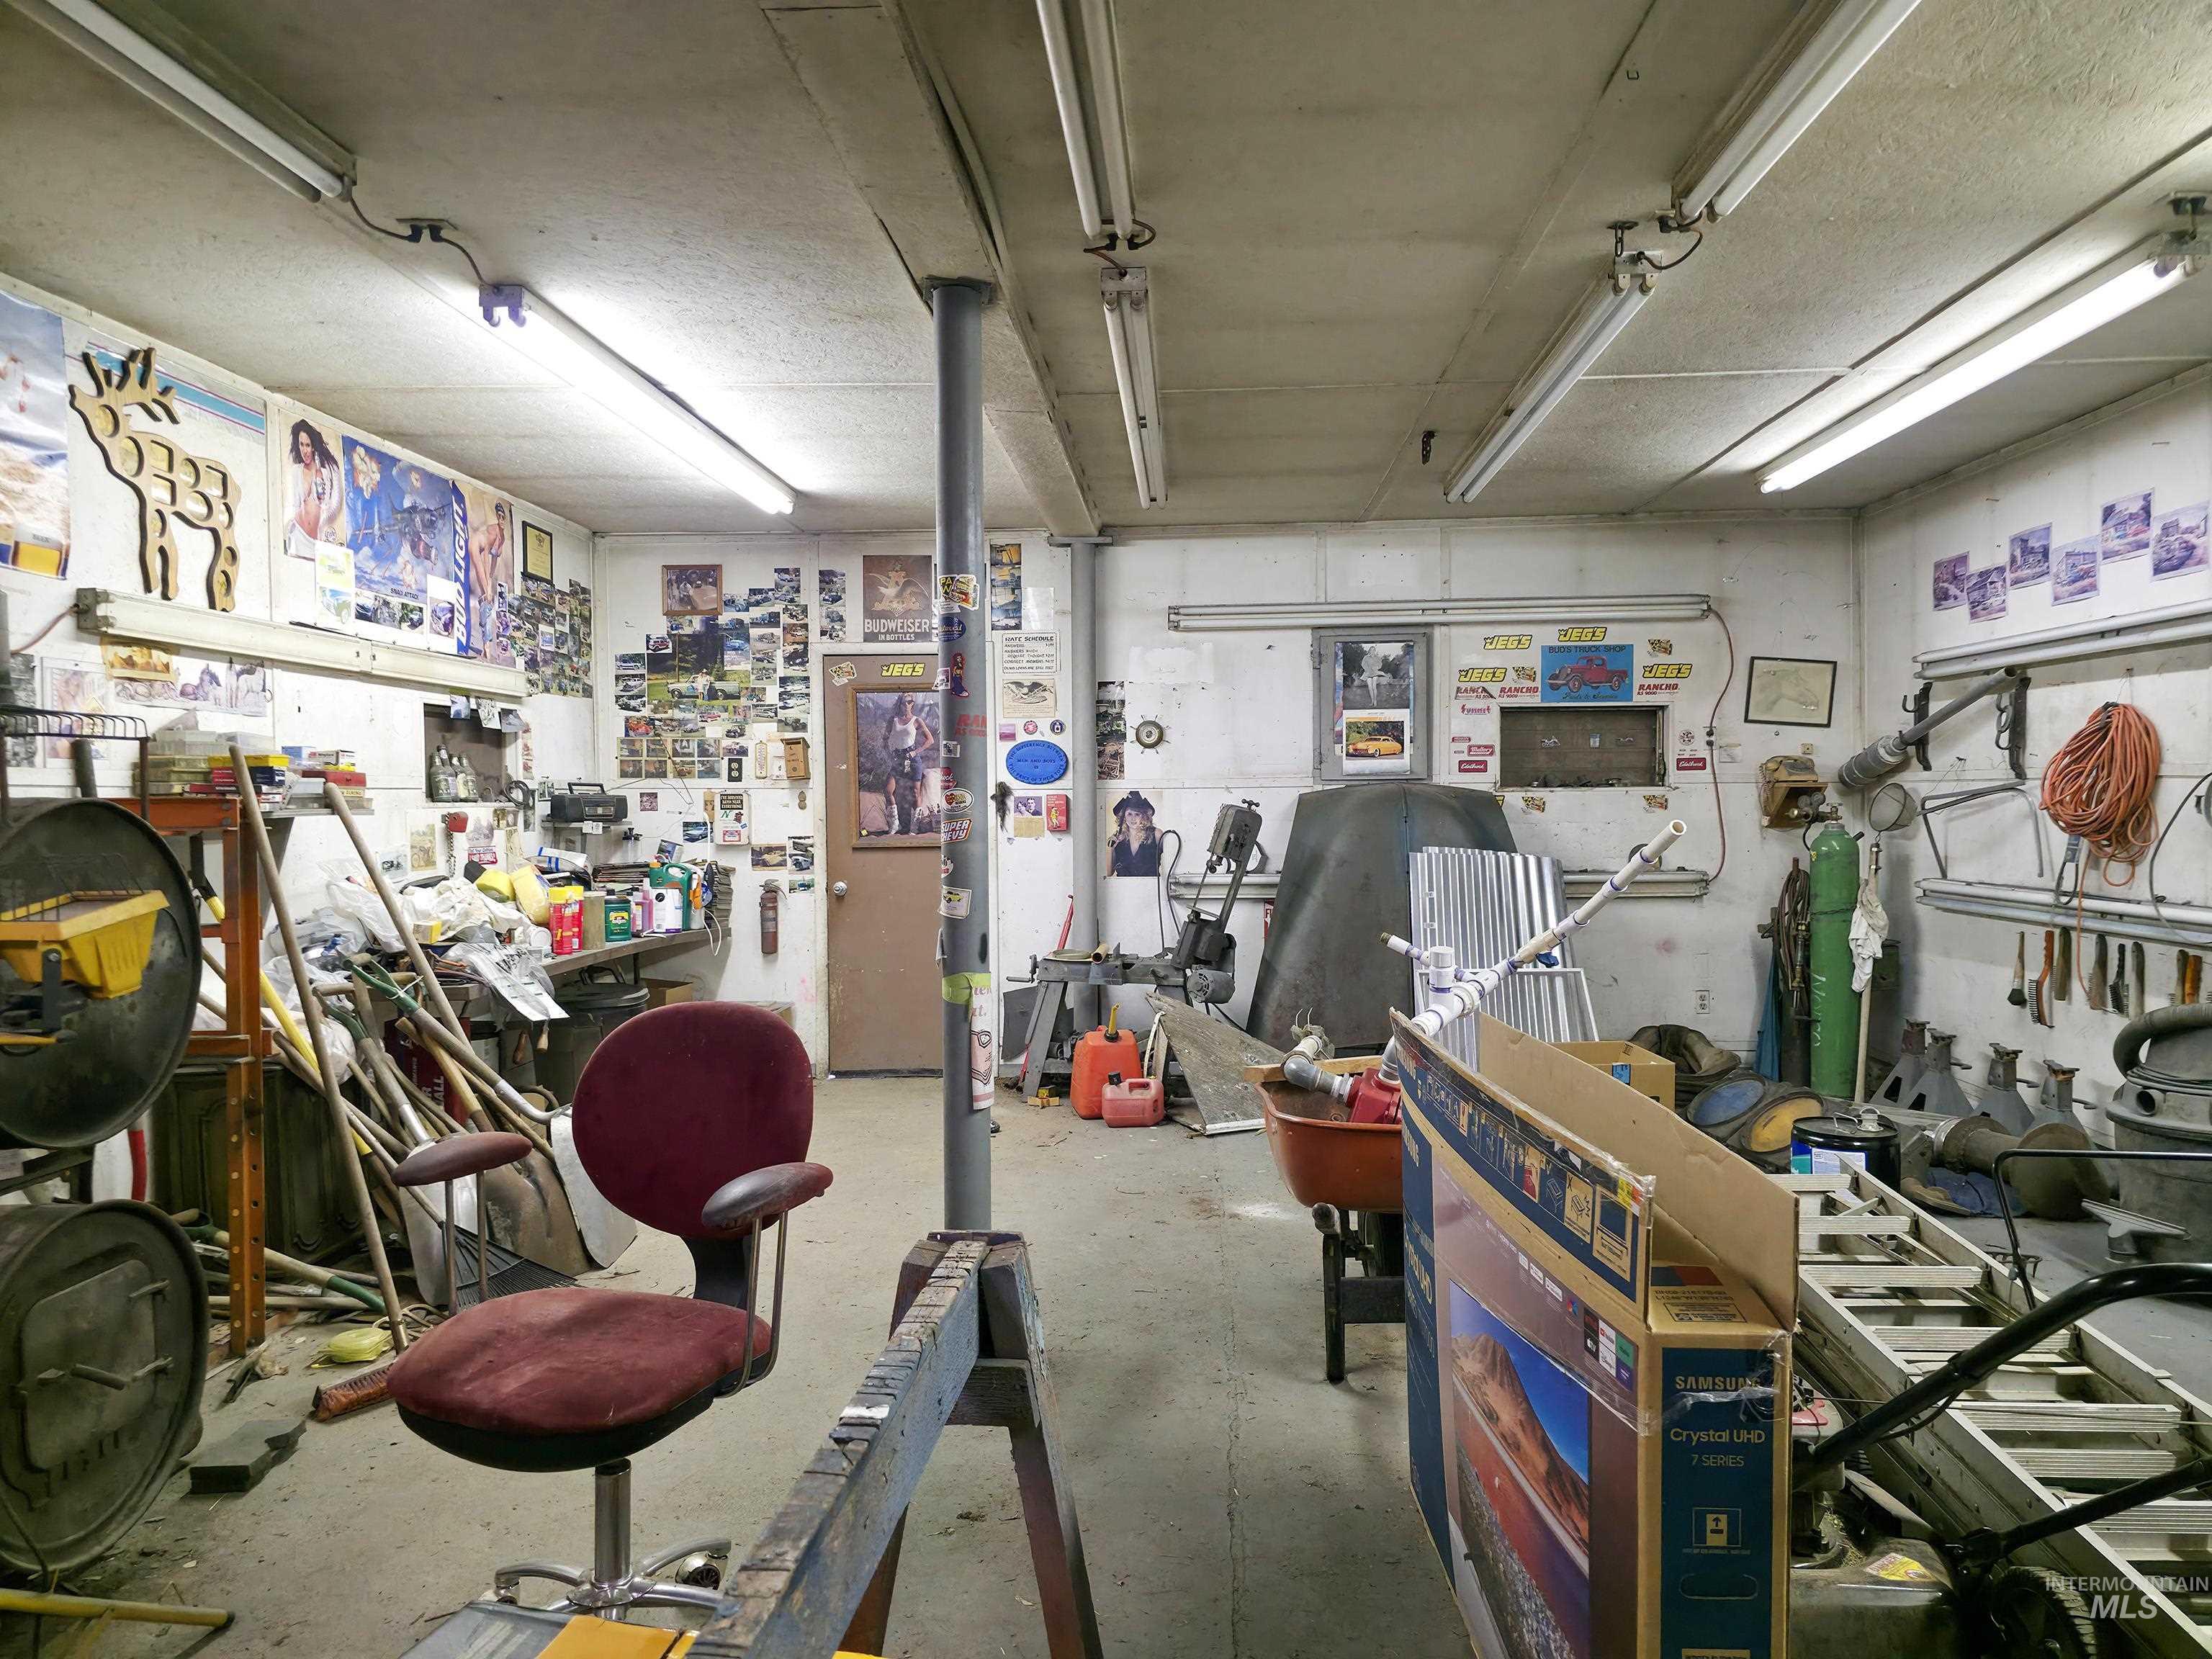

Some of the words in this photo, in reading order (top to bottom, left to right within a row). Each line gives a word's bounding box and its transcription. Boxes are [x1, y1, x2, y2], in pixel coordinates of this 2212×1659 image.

[456, 582, 467, 646] BUD
[865, 619, 930, 633] BUDWEISER
[1558, 626, 1607, 642] JEG'S
[1484, 634, 1532, 650] JEG'S
[881, 662, 926, 677] JEG'S
[1458, 667, 1507, 683] JEG'S
[1642, 663, 1693, 679] JEG'S
[1500, 686, 1539, 695] RANCHO
[1016, 742, 1046, 751] DIFFERENCE
[941, 819, 968, 833] SUPER
[1675, 1375, 1762, 1390] SAMSUNG
[1670, 1427, 1730, 1446] Crystal
[1732, 1429, 1766, 1444] UHD
[1692, 1454, 1699, 1466] 7
[1701, 1455, 1745, 1467] SERIES
